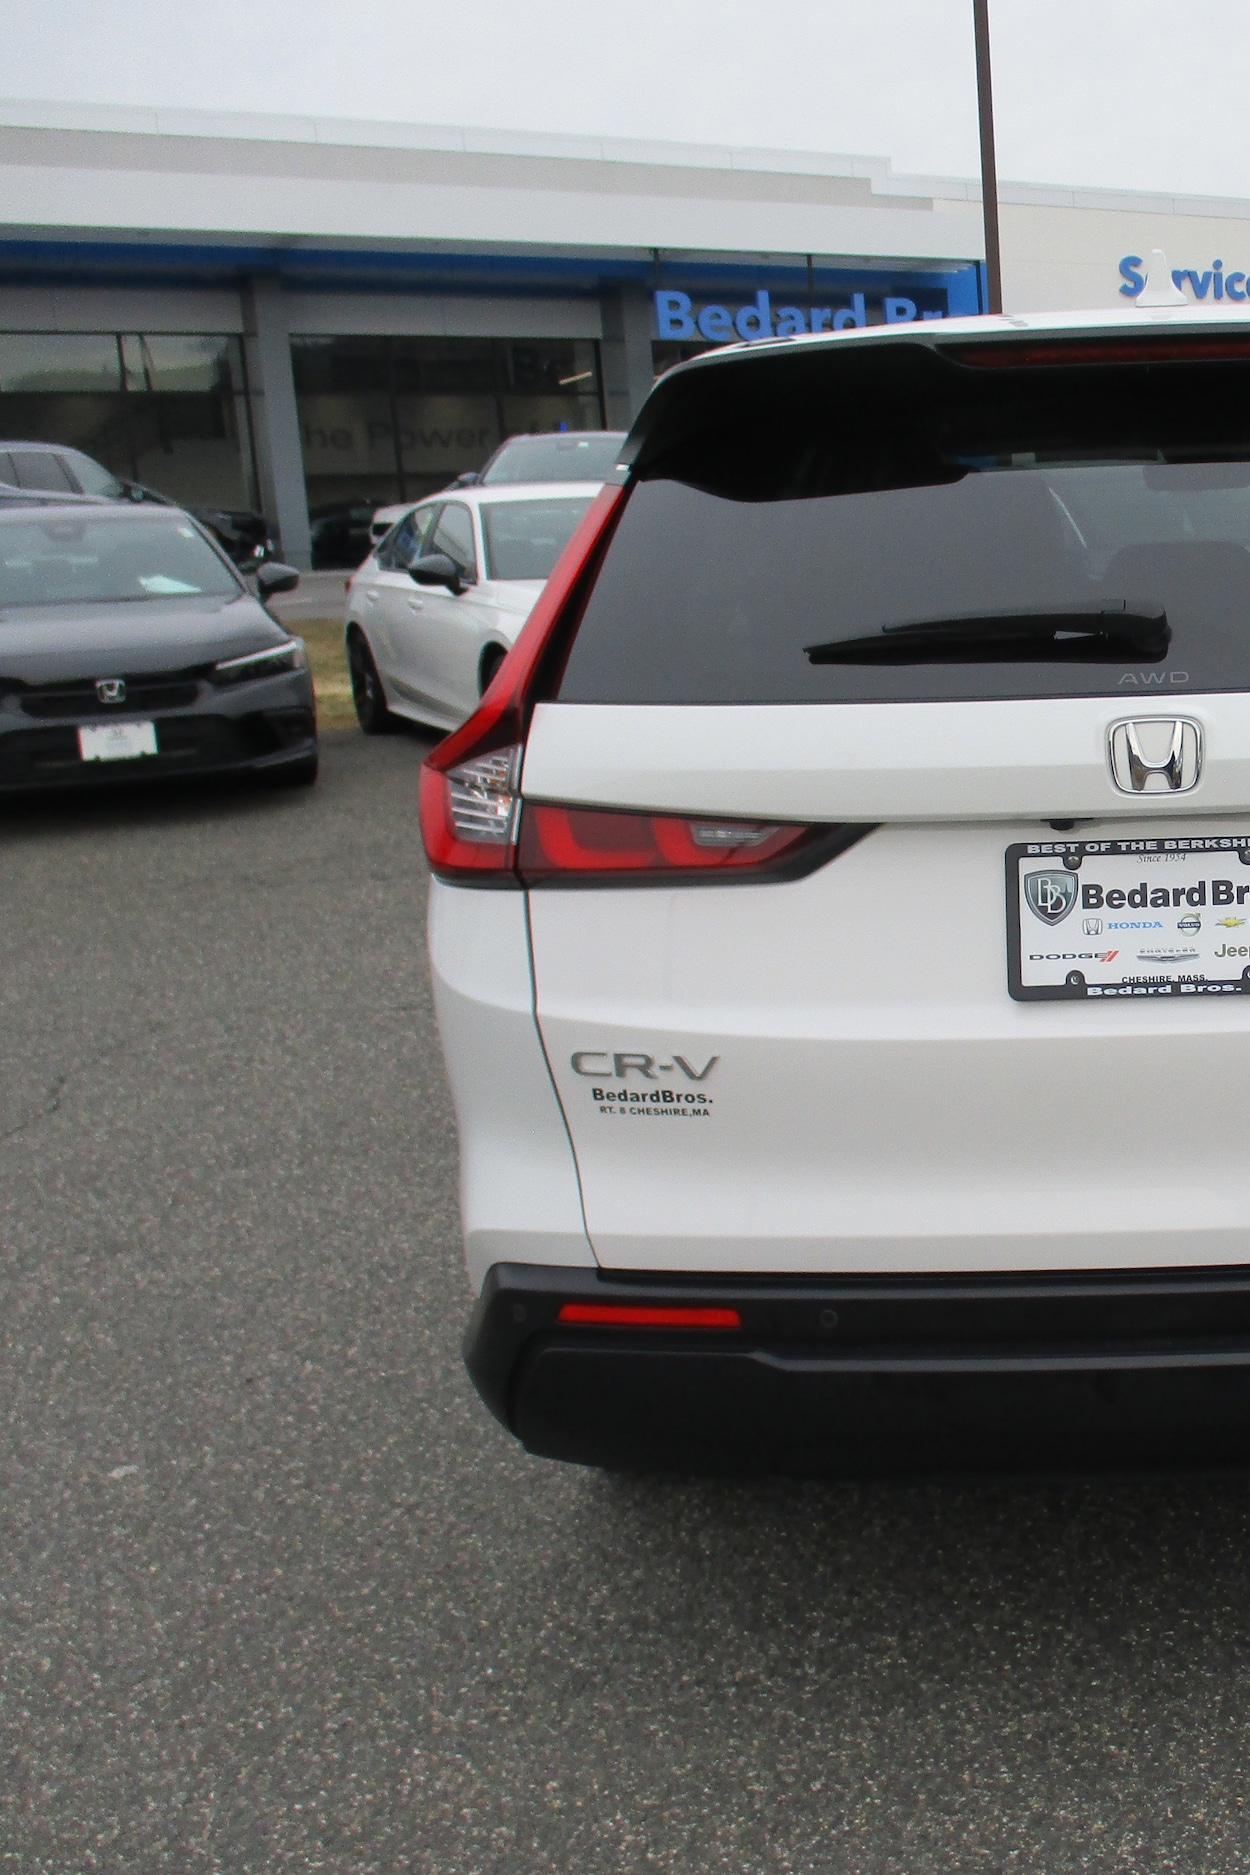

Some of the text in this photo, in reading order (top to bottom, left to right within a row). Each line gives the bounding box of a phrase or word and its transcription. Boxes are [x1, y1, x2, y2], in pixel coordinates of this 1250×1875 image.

[654, 289, 866, 341] Bedard
[303, 422, 351, 450] he
[367, 421, 492, 449] Power
[1117, 671, 1190, 685] AWD
[1027, 843, 1079, 854] BEST
[1085, 843, 1111, 852] OF
[1117, 841, 1158, 851] THE
[1136, 853, 1187, 864] Since 1954
[1081, 881, 1206, 910] Bedard
[1107, 921, 1164, 930] HONDA
[1029, 952, 1108, 961] DODGE
[1178, 974, 1209, 982] MASS.
[1087, 983, 1242, 996] Bedard Bros.
[570, 1051, 721, 1082] CR-V
[600, 1106, 616, 1115] RT.
